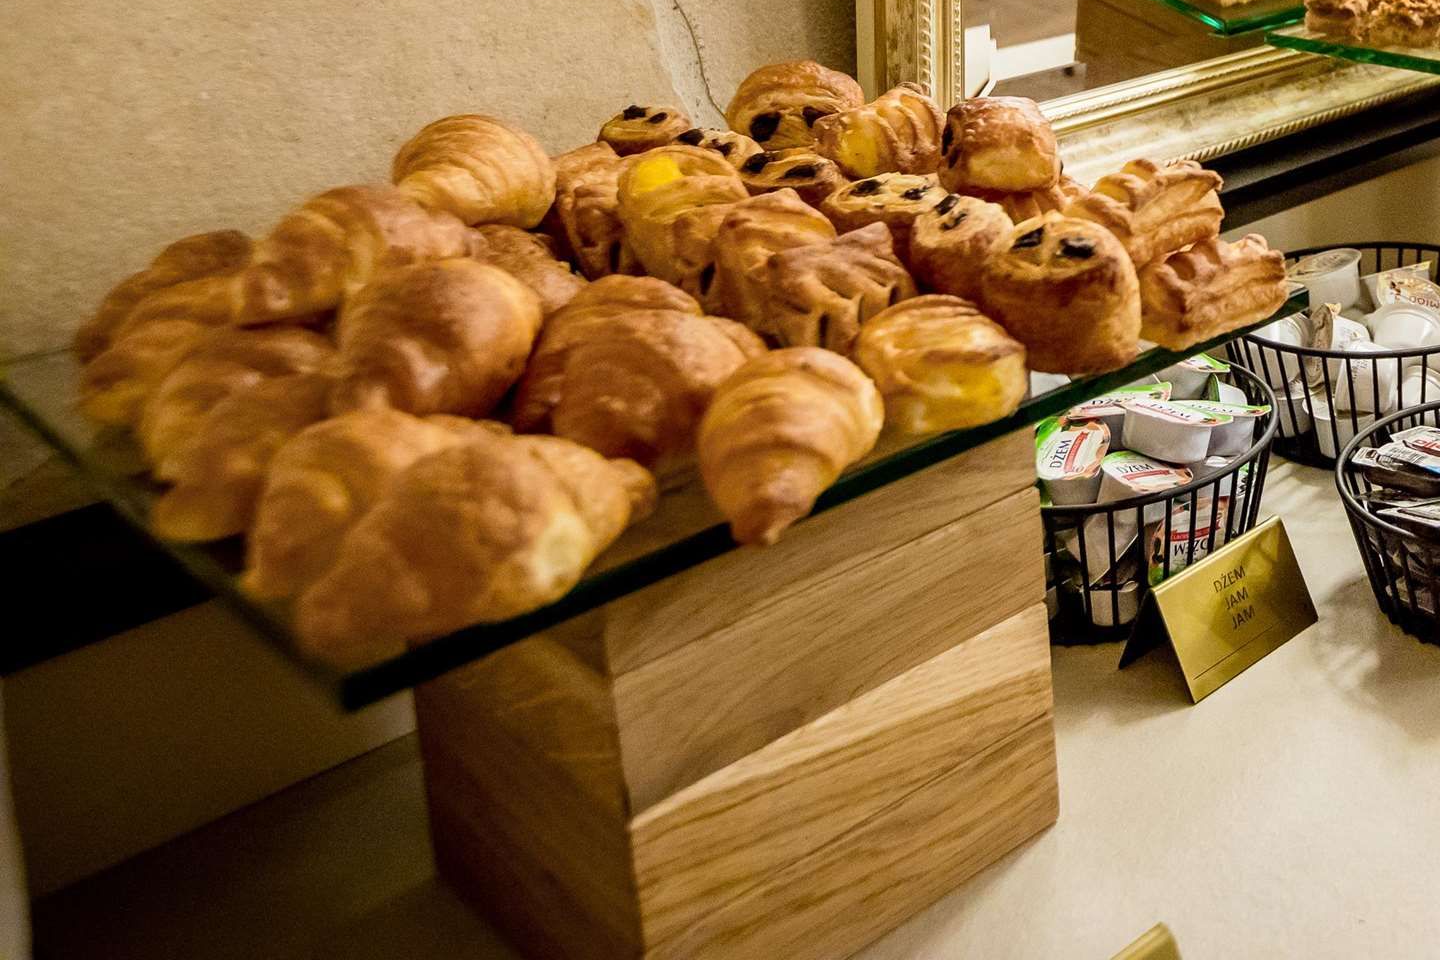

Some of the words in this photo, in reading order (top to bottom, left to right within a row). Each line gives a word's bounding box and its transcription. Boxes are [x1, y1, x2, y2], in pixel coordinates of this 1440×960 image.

[1049, 439, 1073, 469] DŻEM
[1115, 461, 1154, 474] DŻEM
[1173, 539, 1209, 557] DŻM
[1212, 564, 1246, 592] DŻEM
[1225, 588, 1249, 610] JAM
[1232, 606, 1256, 630] JAM
